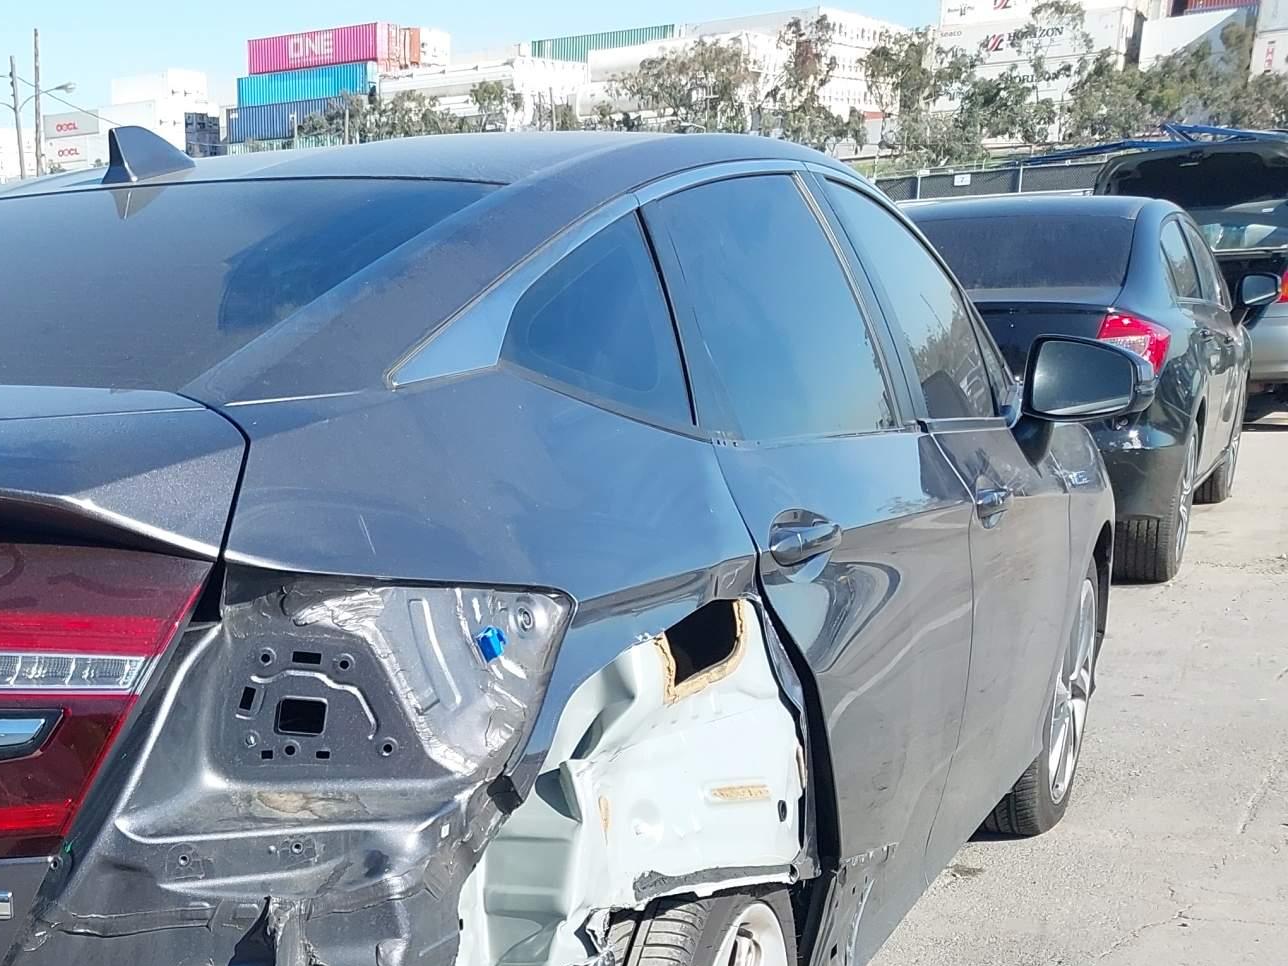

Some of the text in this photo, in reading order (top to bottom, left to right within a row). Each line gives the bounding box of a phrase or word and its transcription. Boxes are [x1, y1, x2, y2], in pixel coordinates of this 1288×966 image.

[288, 32, 333, 58] ONE
[56, 122, 78, 132] OOCL
[57, 148, 80, 157] OOCL
